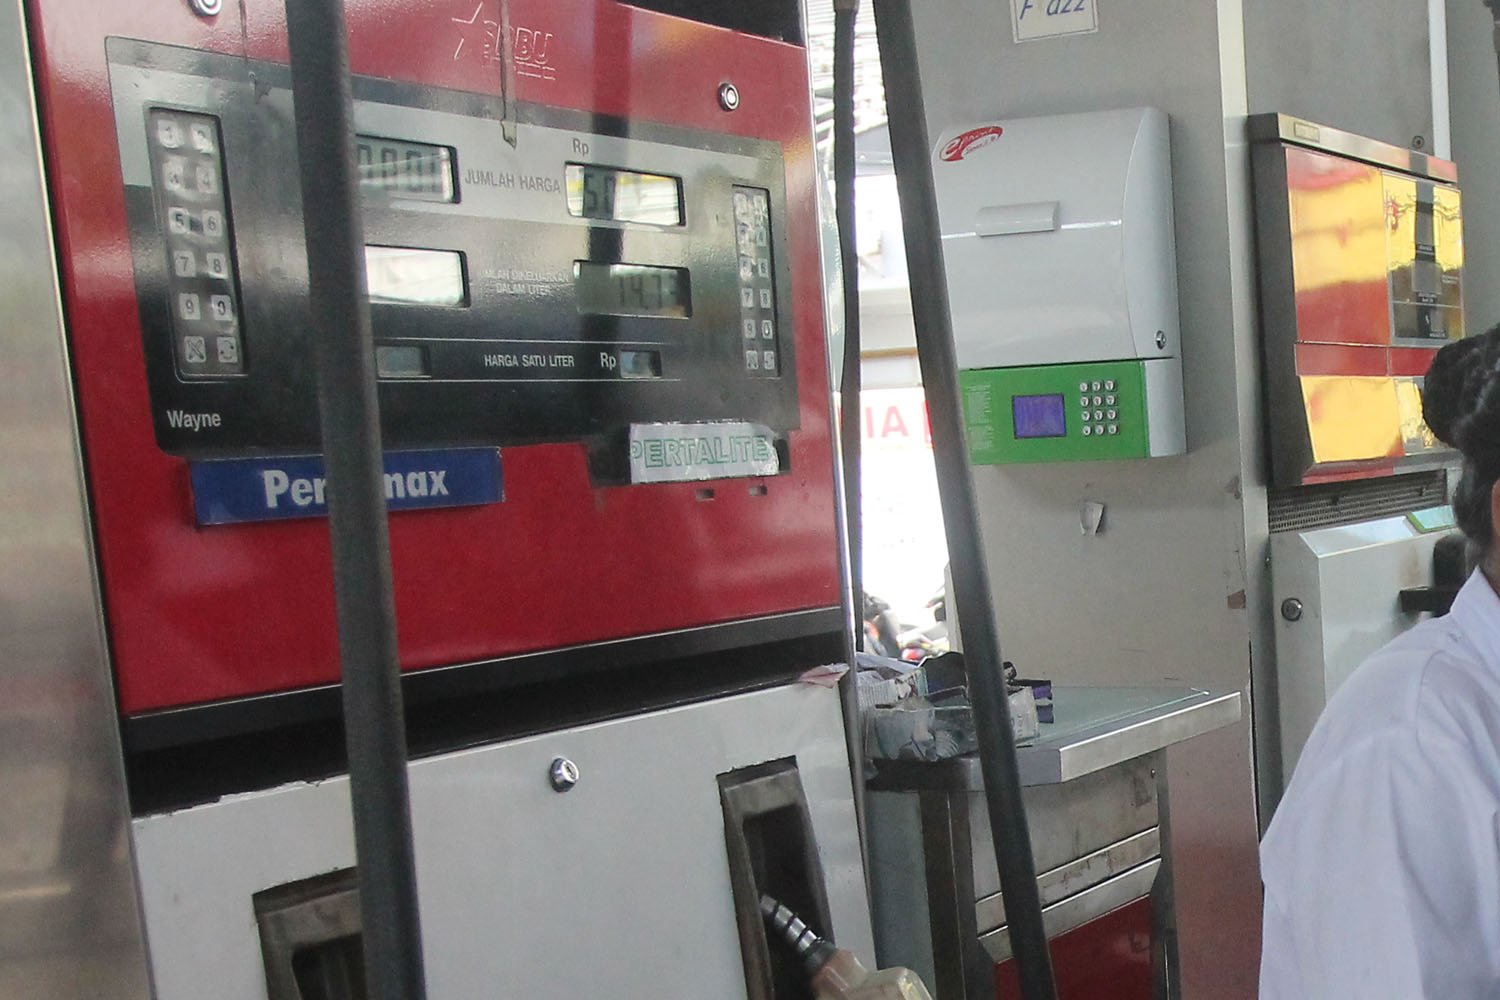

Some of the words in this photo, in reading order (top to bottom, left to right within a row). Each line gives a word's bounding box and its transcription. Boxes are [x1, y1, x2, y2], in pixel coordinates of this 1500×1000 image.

[573, 138, 589, 156] Rp
[464, 169, 515, 188] JUMLAH
[520, 177, 561, 194] HARGA
[484, 354, 518, 368] HARGA
[522, 354, 546, 367] SATU
[549, 354, 575, 367] LITER
[600, 352, 616, 370] Rp
[167, 410, 221, 431] Wayne
[631, 435, 770, 469] PERTALITE
[263, 469, 449, 508] Permax
